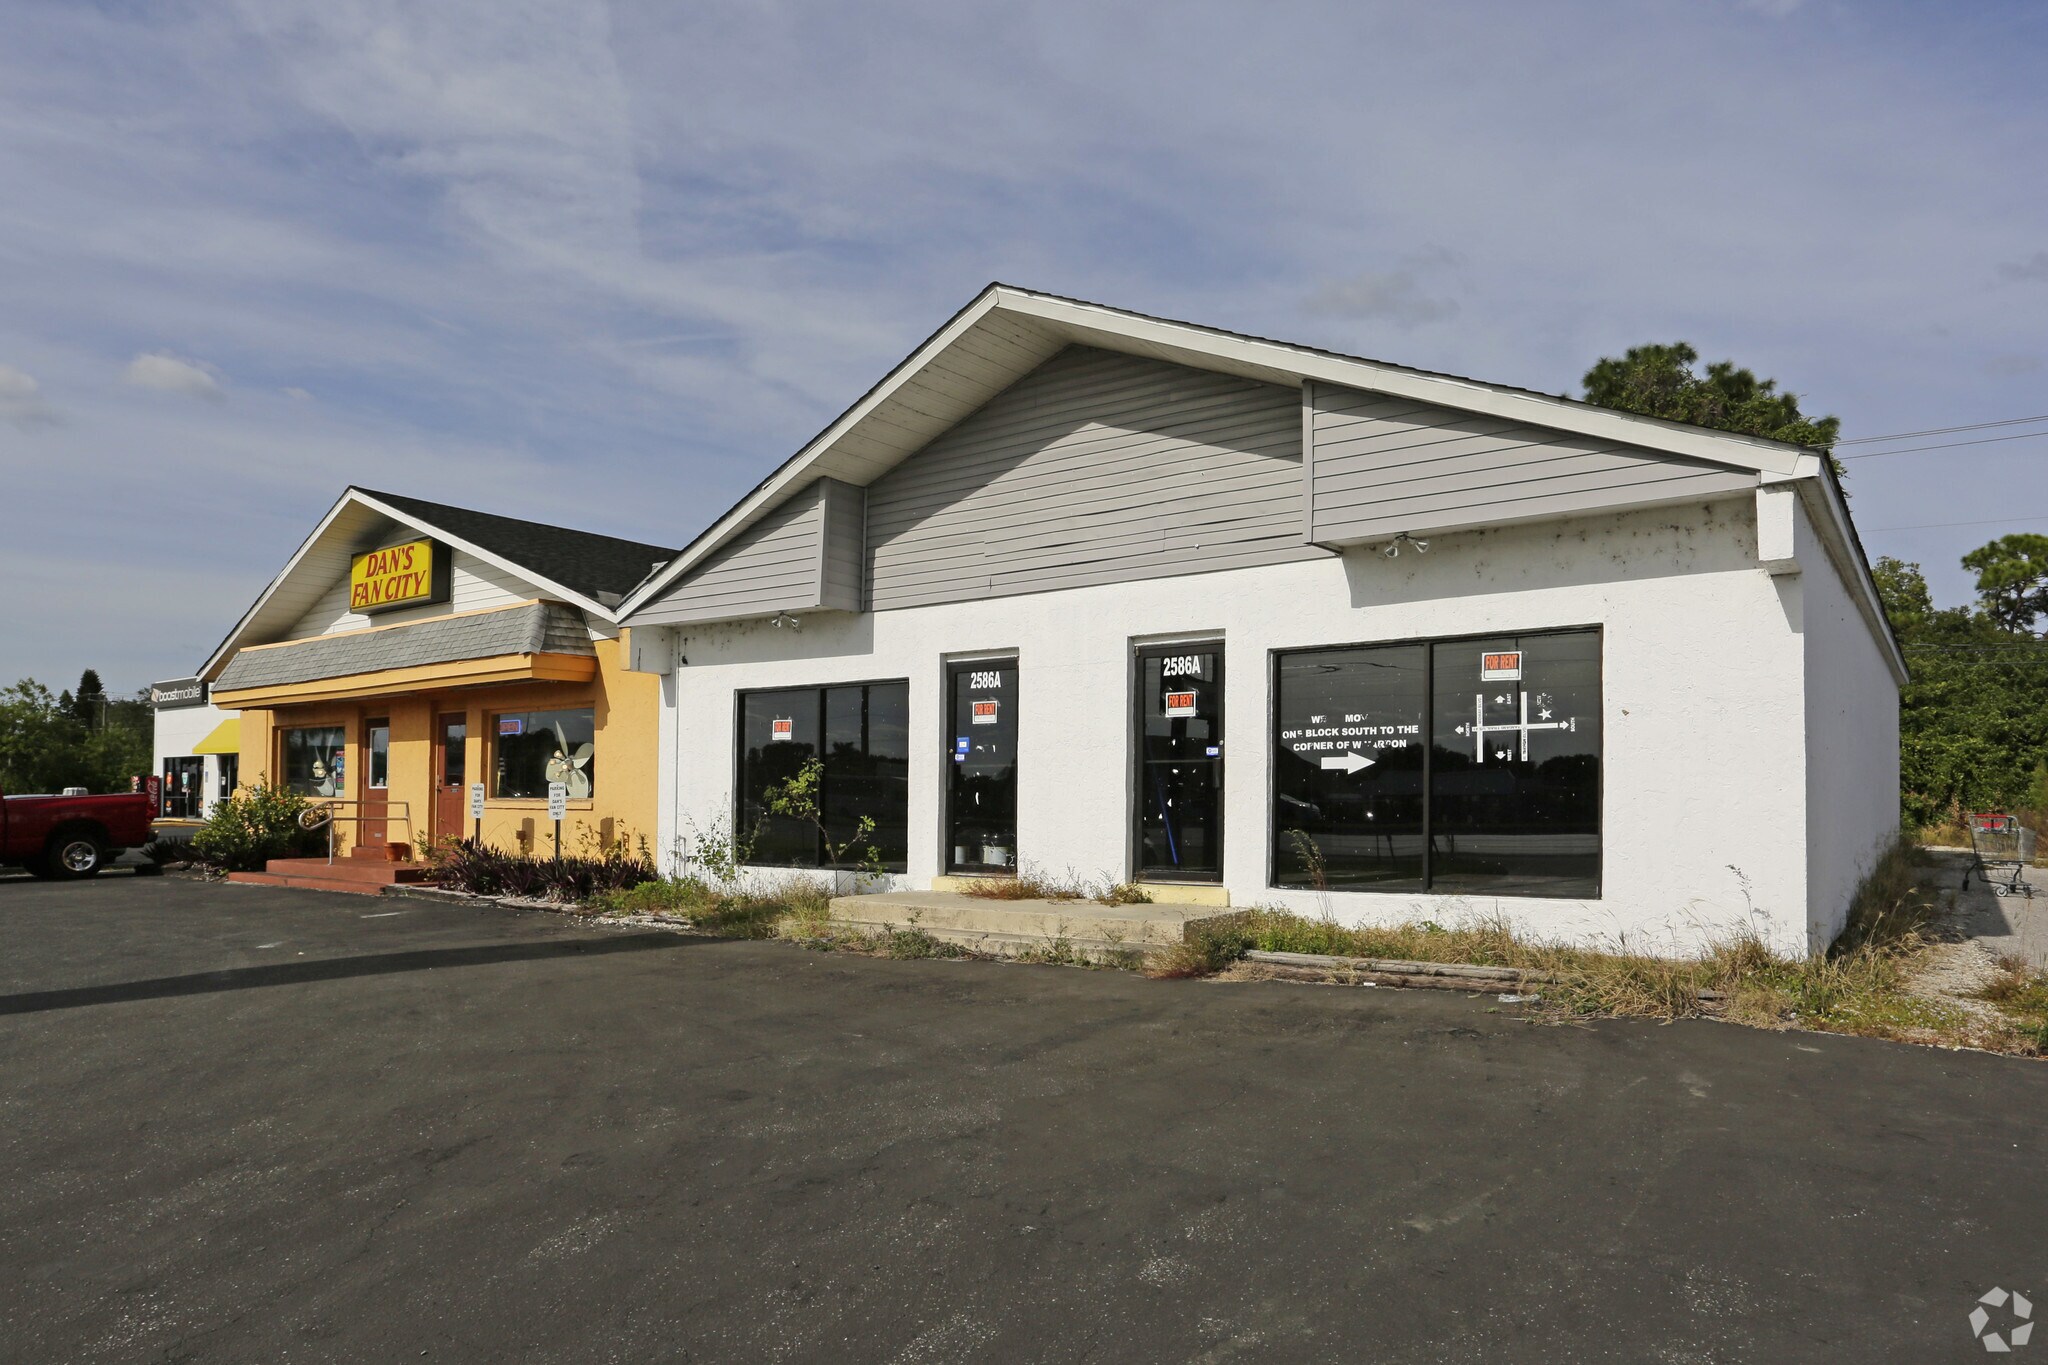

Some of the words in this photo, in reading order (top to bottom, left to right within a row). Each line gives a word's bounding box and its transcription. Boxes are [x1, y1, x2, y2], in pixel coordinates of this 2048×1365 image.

[365, 546, 414, 578] DAN'S
[352, 579, 383, 606] FAN
[385, 570, 427, 600] CITY
[1163, 655, 1201, 676] 2586A
[1485, 655, 1499, 669] FOR
[1500, 654, 1518, 668] RENT
[970, 671, 1001, 689] 2586A
[1168, 695, 1179, 708] FOR
[1180, 694, 1193, 707] RENT
[1305, 728, 1339, 737] BLOCK
[1341, 727, 1377, 736] SOUTH
[1380, 726, 1394, 735] TO
[1397, 725, 1419, 734] THE
[1336, 741, 1350, 749] OF
